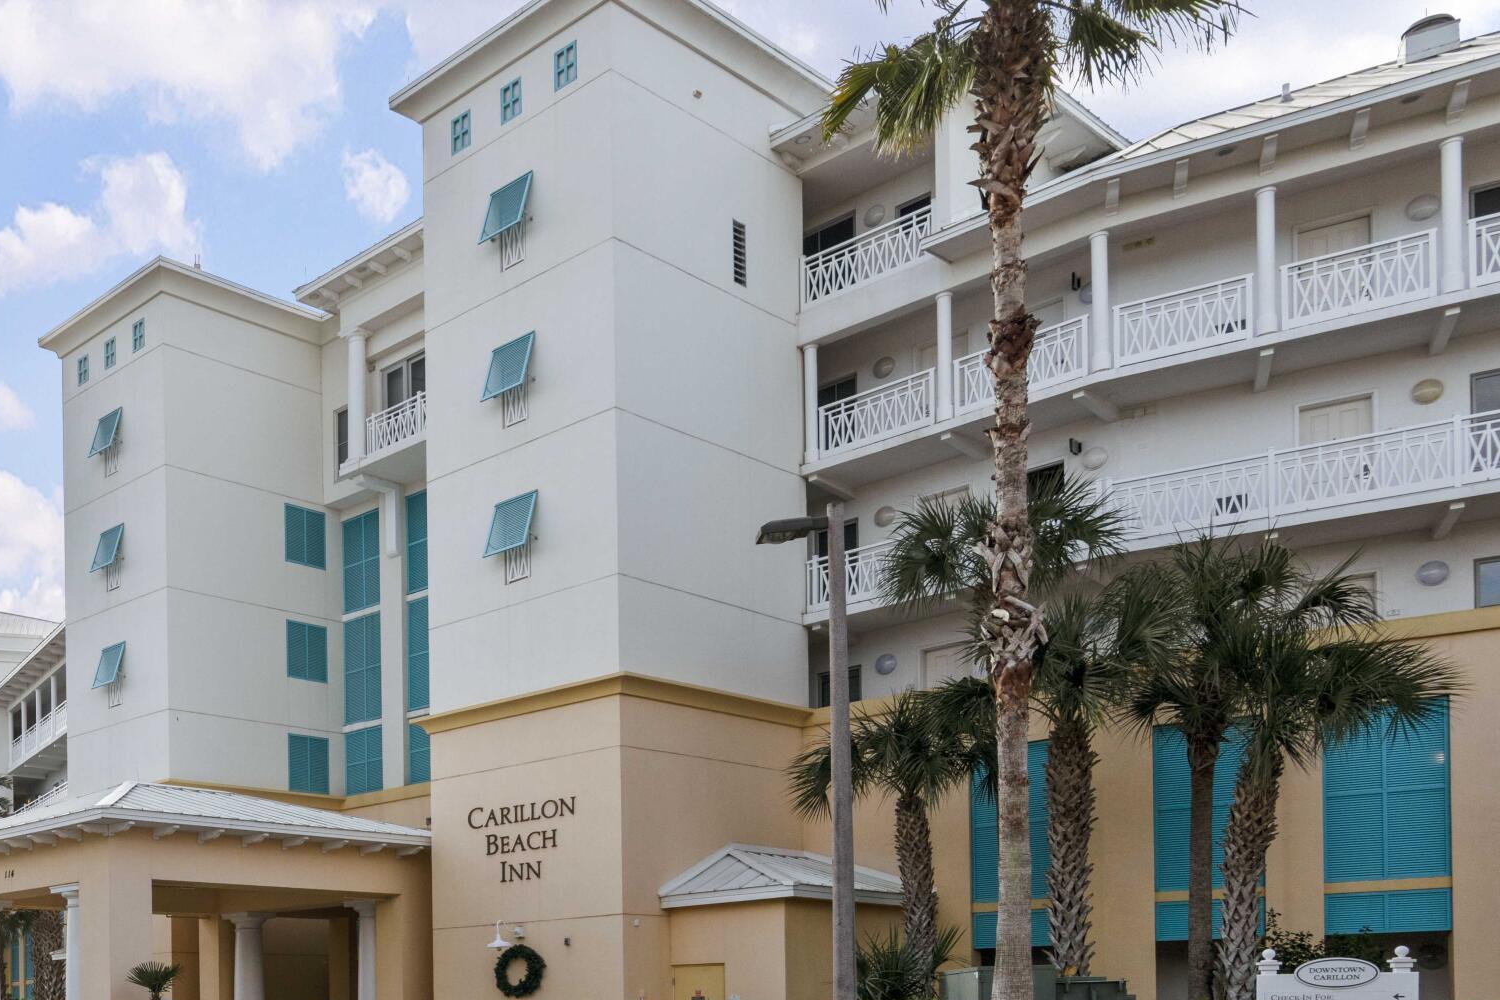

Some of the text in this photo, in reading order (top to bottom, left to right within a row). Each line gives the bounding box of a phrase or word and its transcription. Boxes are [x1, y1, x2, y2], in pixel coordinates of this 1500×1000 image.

[467, 796, 576, 829] CARILLON
[485, 829, 558, 856] BEACH
[500, 860, 542, 883] INN
